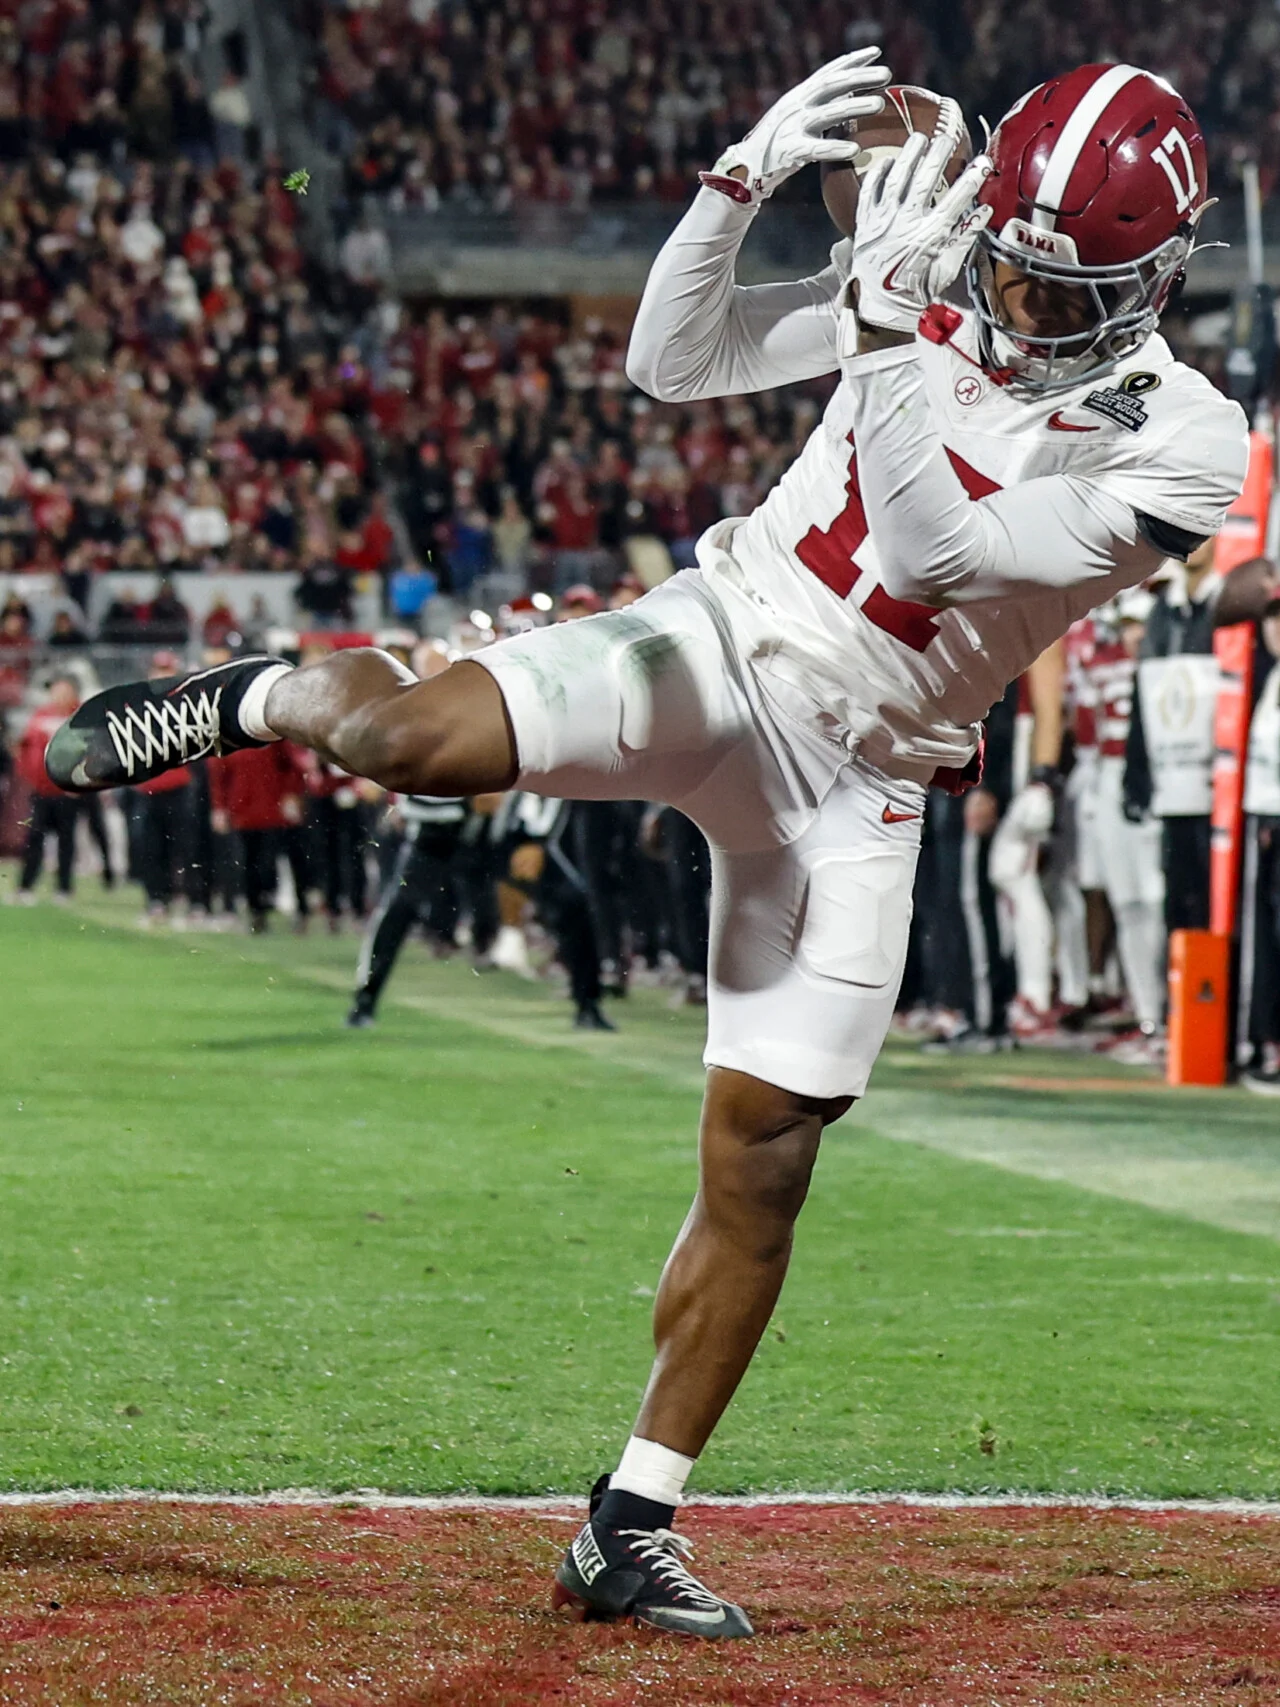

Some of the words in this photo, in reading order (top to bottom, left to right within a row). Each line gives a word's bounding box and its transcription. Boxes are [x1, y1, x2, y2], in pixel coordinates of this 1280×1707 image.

[1150, 126, 1199, 215] 17
[1016, 229, 1057, 254] BAMA
[1090, 392, 1116, 407] FIRST
[1114, 401, 1146, 422] ROUND
[1104, 389, 1143, 409] PLAYOFF
[573, 1527, 605, 1584] NIKE
